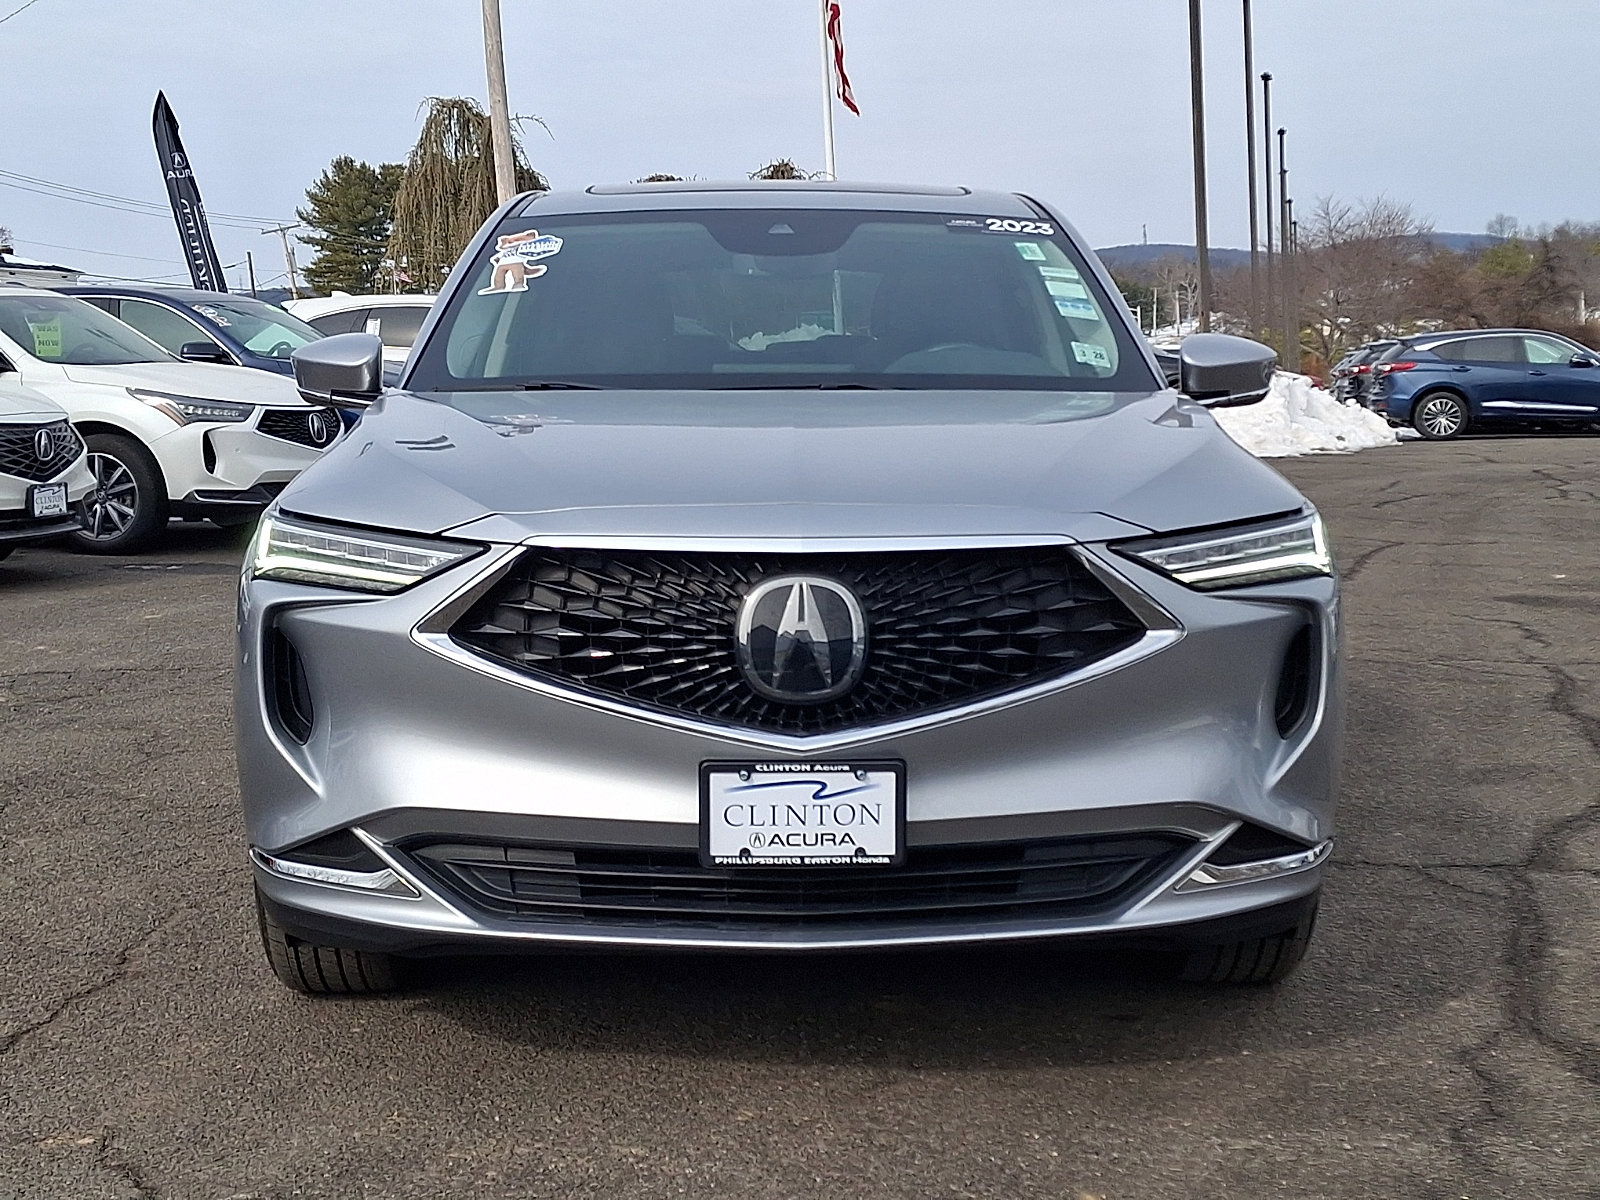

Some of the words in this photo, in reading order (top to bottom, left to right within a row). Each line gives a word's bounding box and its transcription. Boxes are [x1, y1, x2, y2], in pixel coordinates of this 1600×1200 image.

[985, 218, 1055, 235] 2023
[755, 764, 811, 772] CLINTON
[813, 764, 850, 772] Acura
[723, 803, 882, 827] CLINTON
[767, 832, 856, 847] ACURA
[804, 856, 850, 864] EASTON
[852, 856, 890, 864] Honda
